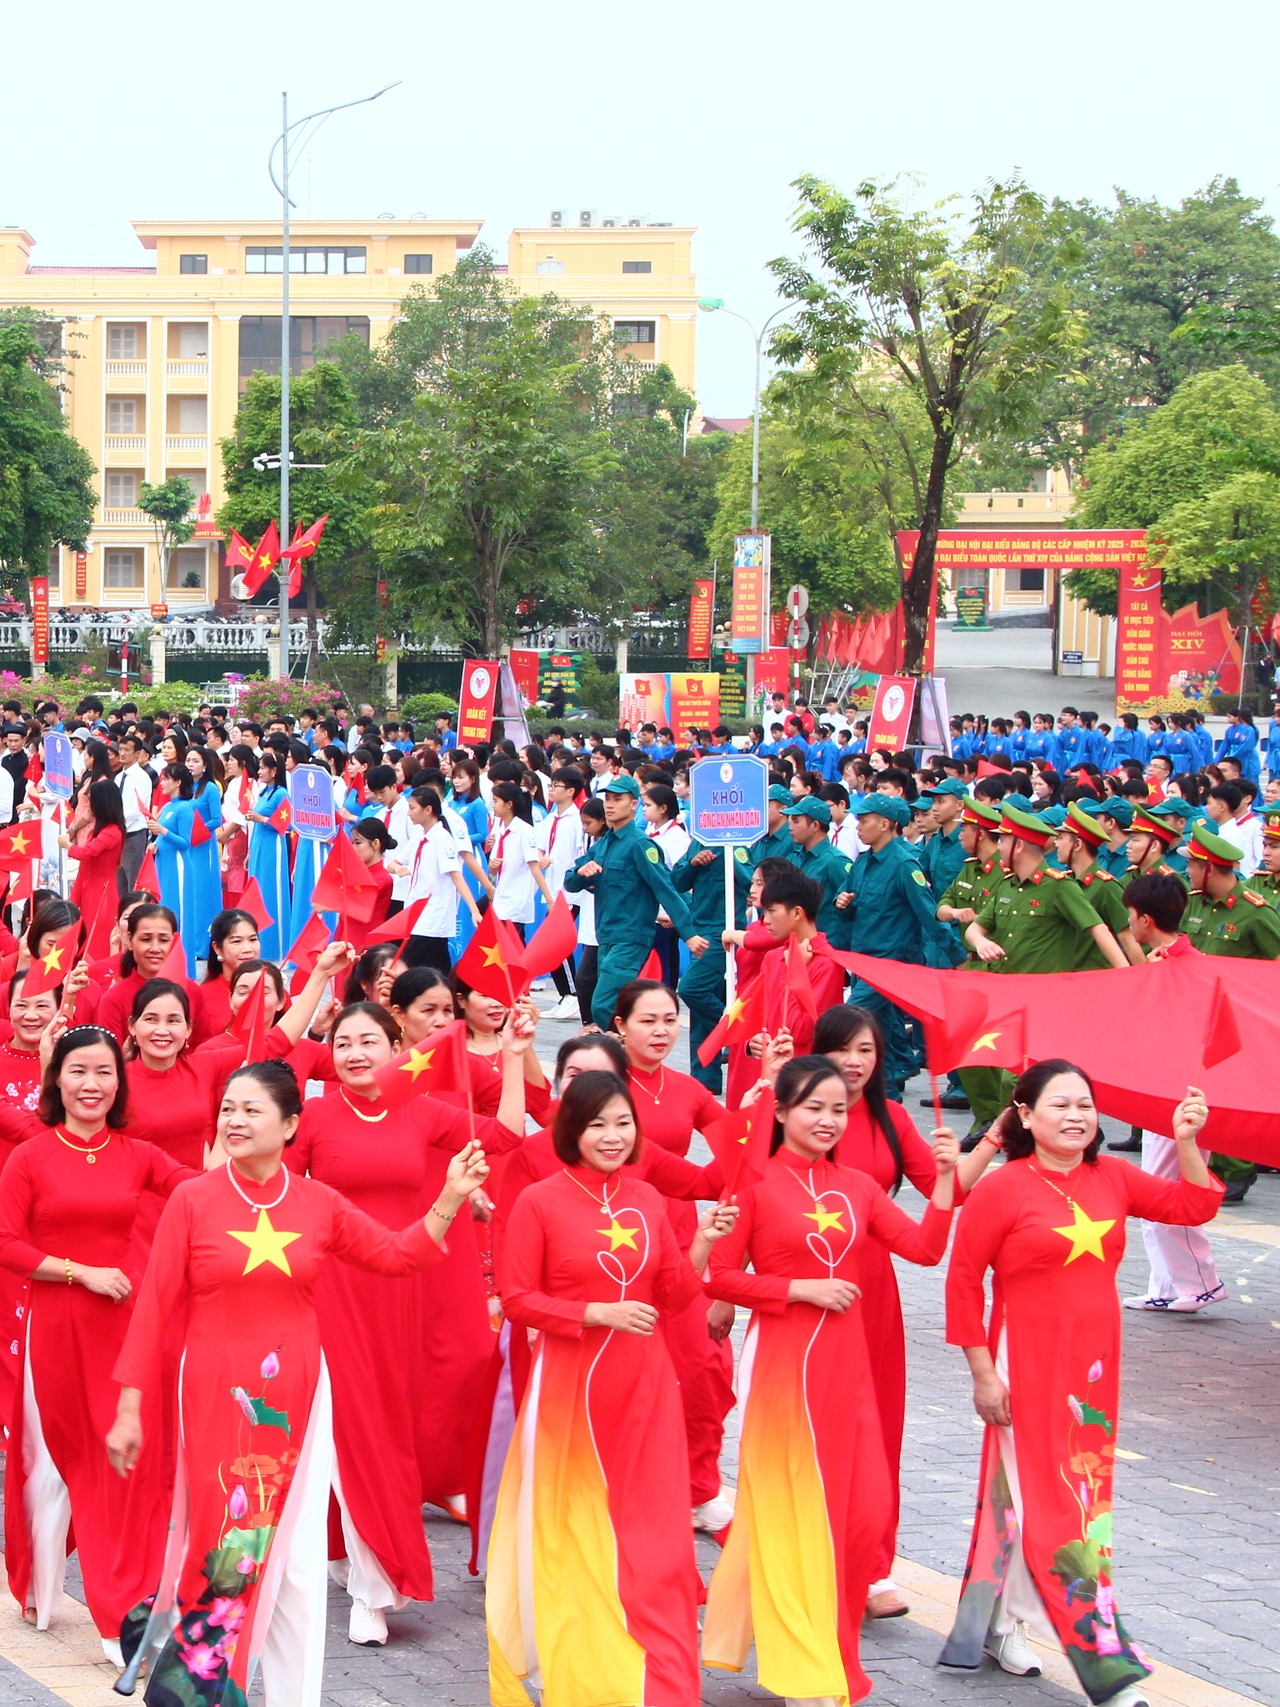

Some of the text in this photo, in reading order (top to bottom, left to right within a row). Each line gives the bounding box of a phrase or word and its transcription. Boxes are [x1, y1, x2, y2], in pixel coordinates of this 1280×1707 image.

[956, 540, 967, 551] ĐẠI
[969, 539, 980, 551] HỘI
[982, 540, 993, 551] ĐẠI
[1011, 538, 1030, 549] ĐẢNG
[1032, 539, 1040, 551] BỘ
[1042, 539, 1056, 549] CÁC
[1058, 538, 1071, 549] CẤP
[1073, 539, 1095, 550] NHIỆM
[1107, 540, 1124, 549] 2025
[940, 553, 951, 564] ĐẠI
[953, 551, 968, 562] BIỂU
[970, 552, 987, 562] TOÀN
[989, 552, 1007, 563] QUỐC
[1037, 554, 1048, 562] XIV
[1049, 552, 1063, 562] CỦA
[1065, 551, 1083, 562] ĐẢNG
[1085, 552, 1103, 564] CỘNG
[1105, 551, 1119, 562] SẢN
[1121, 552, 1135, 563] VIỆT
[1130, 600, 1148, 611] TẤT CẢ
[1170, 639, 1205, 649] XIV
[466, 707, 487, 720] ĐOÀN KẾT
[303, 789, 321, 807] KHỐI
[712, 783, 744, 805] KHỐI
[296, 809, 331, 828] DÂN QUÂN
[698, 806, 760, 829] CÔNG AN NHÂN DÂN
